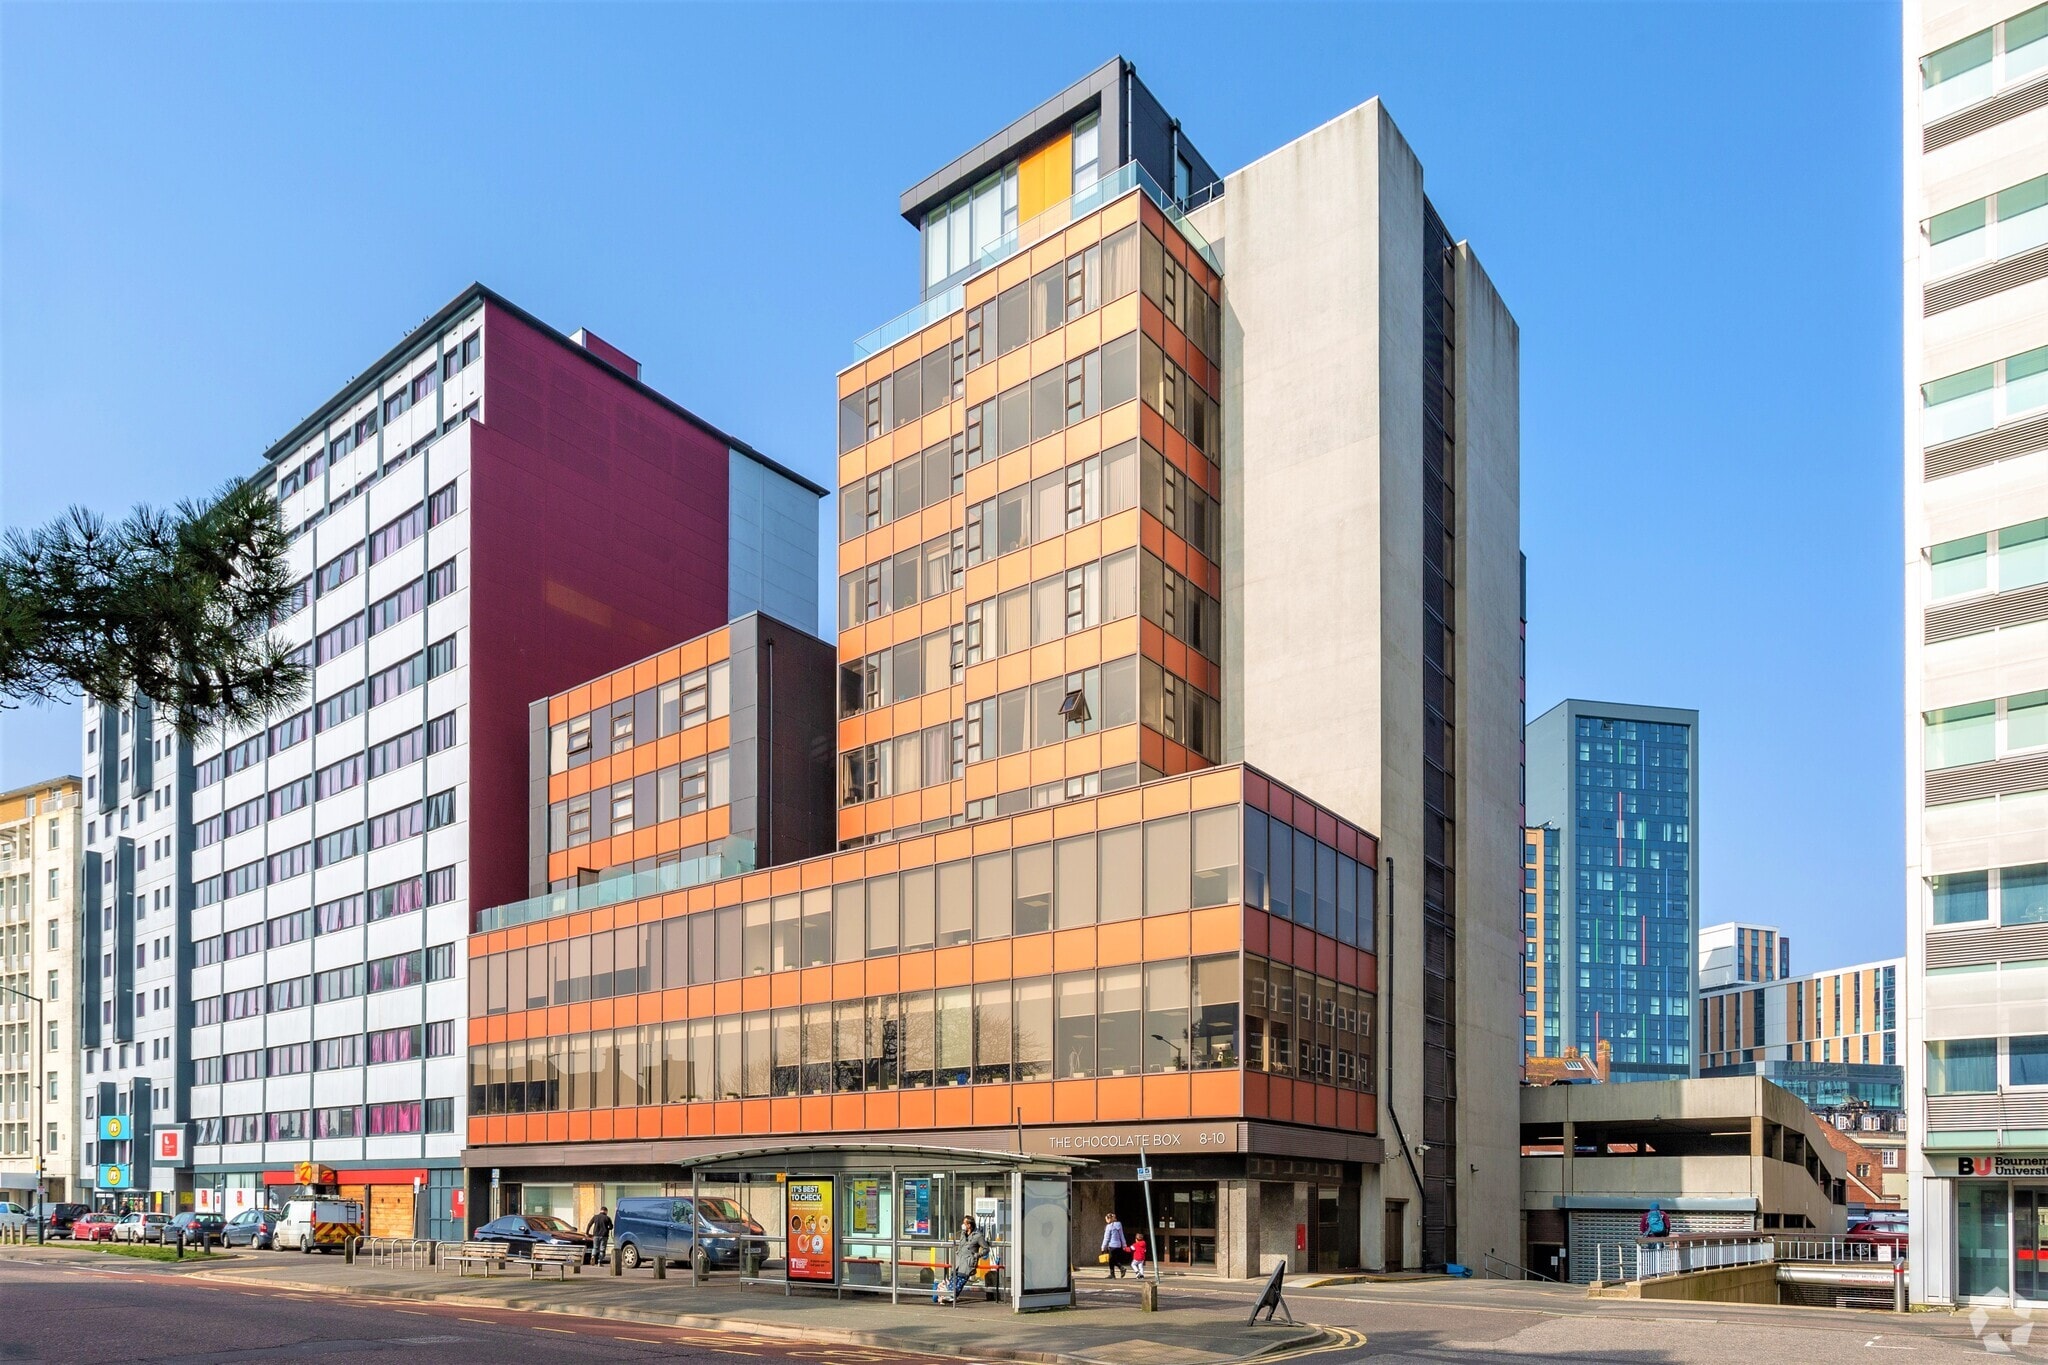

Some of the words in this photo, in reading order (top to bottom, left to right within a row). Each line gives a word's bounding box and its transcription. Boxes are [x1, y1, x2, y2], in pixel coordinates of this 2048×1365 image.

[1049, 1137, 1071, 1148] THE
[1074, 1135, 1149, 1148] CHOCOLATE
[1153, 1134, 1181, 1146] BOX
[1199, 1132, 1226, 1145] 8-10
[1958, 1156, 1992, 1176] BU
[803, 1185, 818, 1193] BEST
